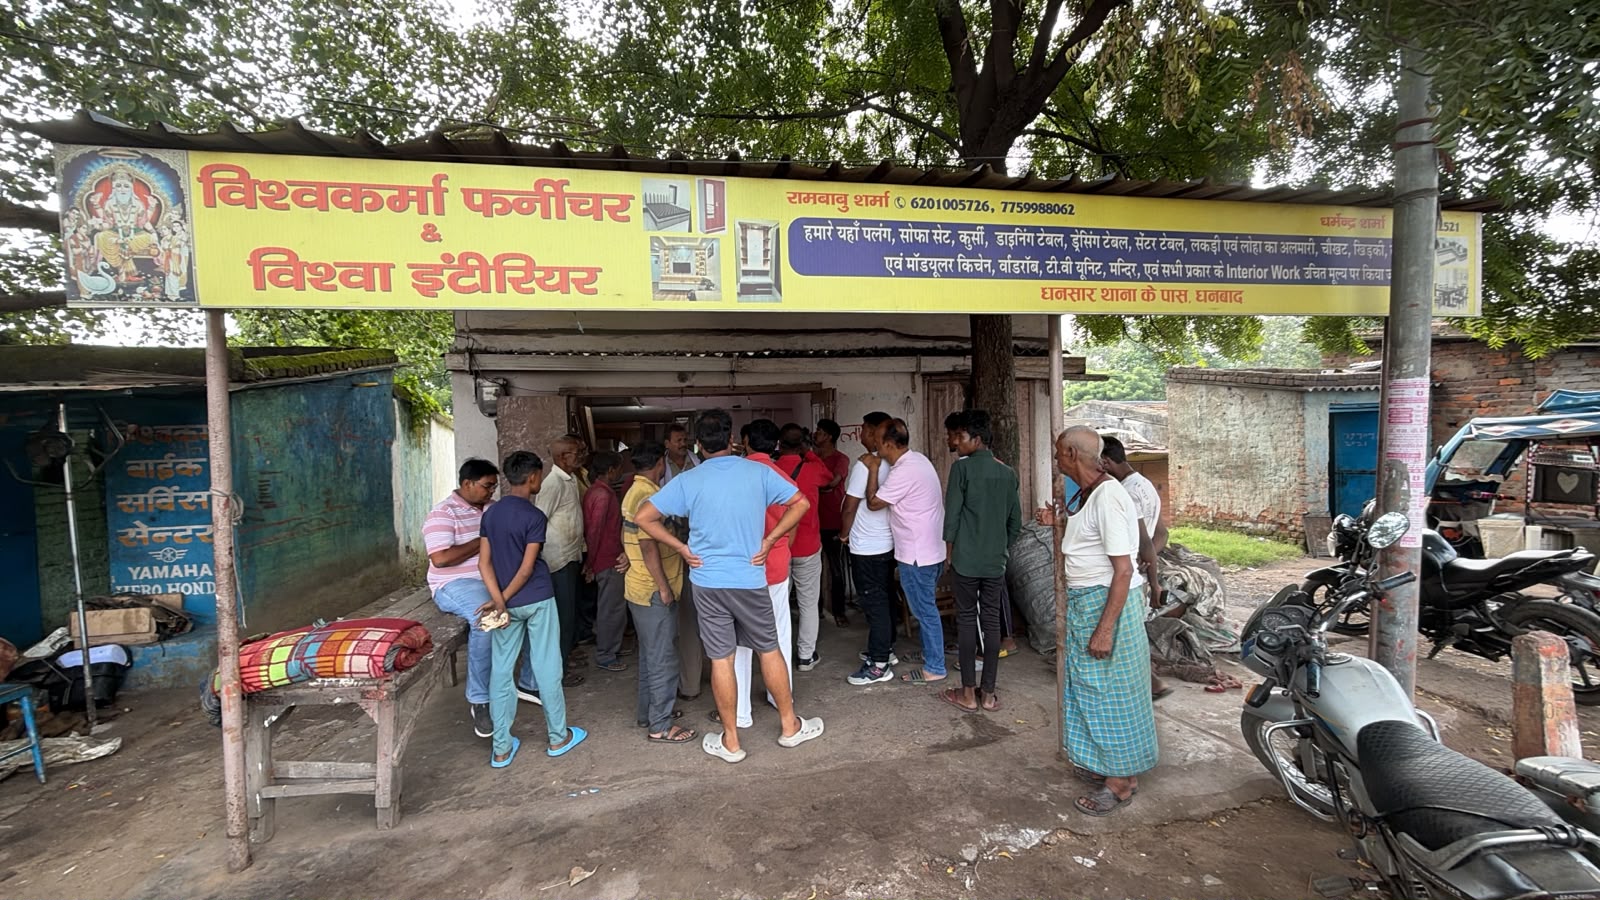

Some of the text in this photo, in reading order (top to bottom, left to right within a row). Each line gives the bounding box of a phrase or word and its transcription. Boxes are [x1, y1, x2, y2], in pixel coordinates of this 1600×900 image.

[196, 163, 635, 222] विश्वकर्मा फर्नीचर
[786, 190, 1075, 215] रामबाबु शर्मा 6201005726, 7759988062
[420, 222, 443, 243] &
[803, 220, 834, 242] हमारे
[836, 220, 860, 243] यहाँ
[861, 223, 896, 246] पलंग,
[898, 223, 930, 243] सोफा
[931, 224, 956, 247] सेट,
[958, 226, 989, 251] कुर्सी,
[994, 228, 1035, 250] डाइनिंग
[1036, 228, 1068, 251] टेबल,
[1070, 229, 1100, 253] ड्रेसिंग
[1101, 231, 1132, 252] टेबल,
[1134, 232, 1157, 252] सेंटर
[1159, 233, 1188, 254] टेबल,
[1190, 235, 1221, 255] लकड़ी
[1223, 236, 1239, 256] एवं
[1240, 236, 1263, 256] लोहा
[1264, 241, 1278, 254] का
[1280, 238, 1319, 257] अलमारी,
[246, 246, 602, 298] विश्वा इंटीरियर
[884, 253, 903, 276] एवं
[957, 253, 996, 276] किचेन,
[1075, 257, 1107, 280] यूनिट,
[1109, 258, 1141, 279] मन्दिर,
[1143, 259, 1160, 280] एवं
[1161, 259, 1183, 277] सभी
[1184, 264, 1212, 278] प्रकार
[1213, 260, 1225, 278] के
[1226, 263, 1268, 279] Interior
[1271, 264, 1300, 280] Work
[1303, 263, 1327, 280] उचित
[1349, 268, 1360, 280] पर
[1362, 264, 1384, 281] किया
[1040, 286, 1097, 303] धनसार
[1101, 287, 1137, 302] थाना
[1140, 285, 1157, 302] के
[117, 520, 214, 546] सेन्टर
[128, 564, 213, 580] YAMAHA
[166, 581, 216, 595] HOND
